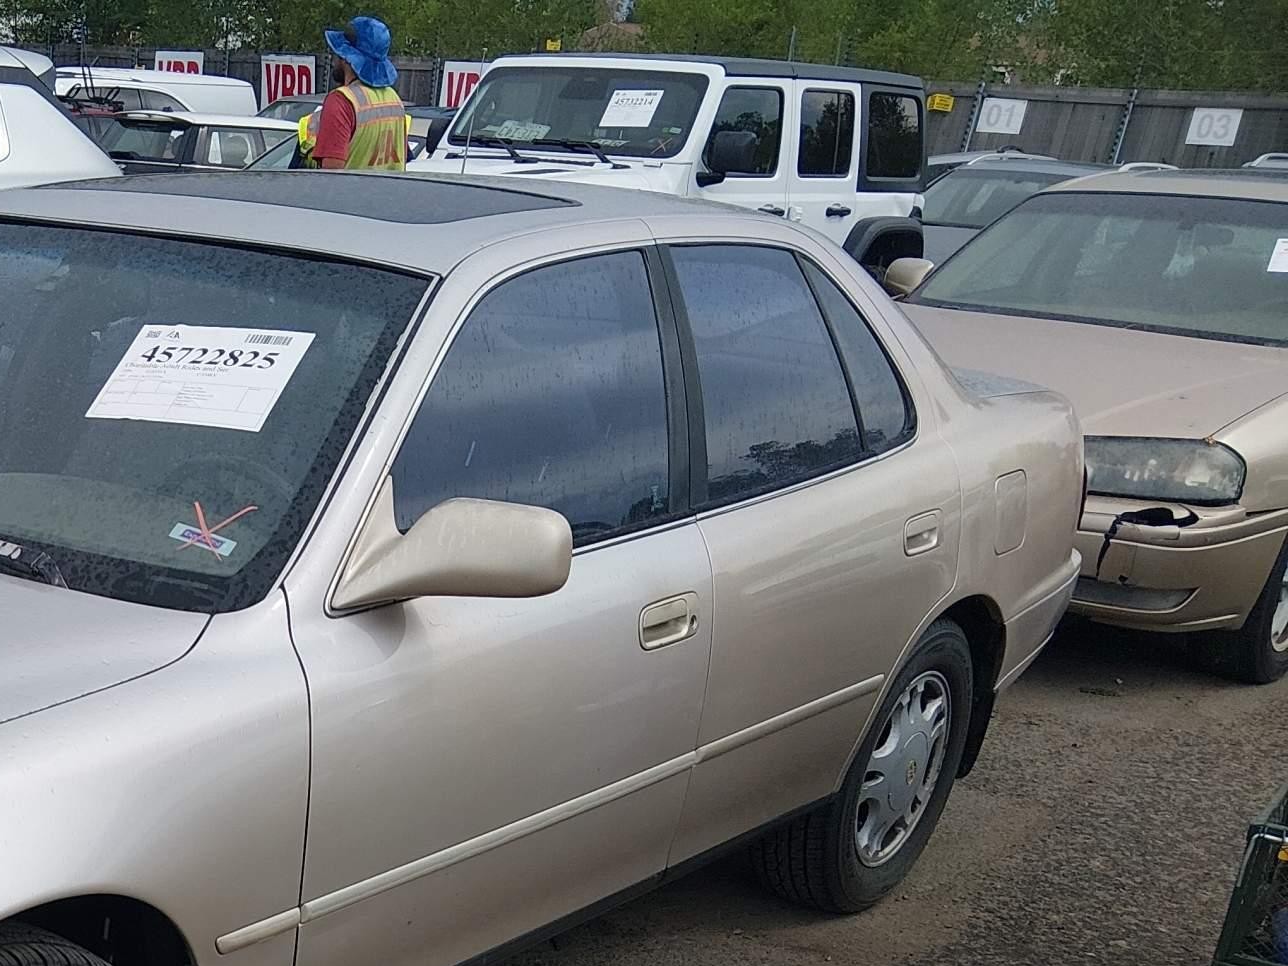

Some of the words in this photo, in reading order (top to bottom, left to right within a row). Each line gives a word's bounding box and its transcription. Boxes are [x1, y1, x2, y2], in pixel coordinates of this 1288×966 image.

[986, 103, 1019, 128] 01
[1196, 113, 1233, 140] 03
[141, 345, 280, 369] 45722825
